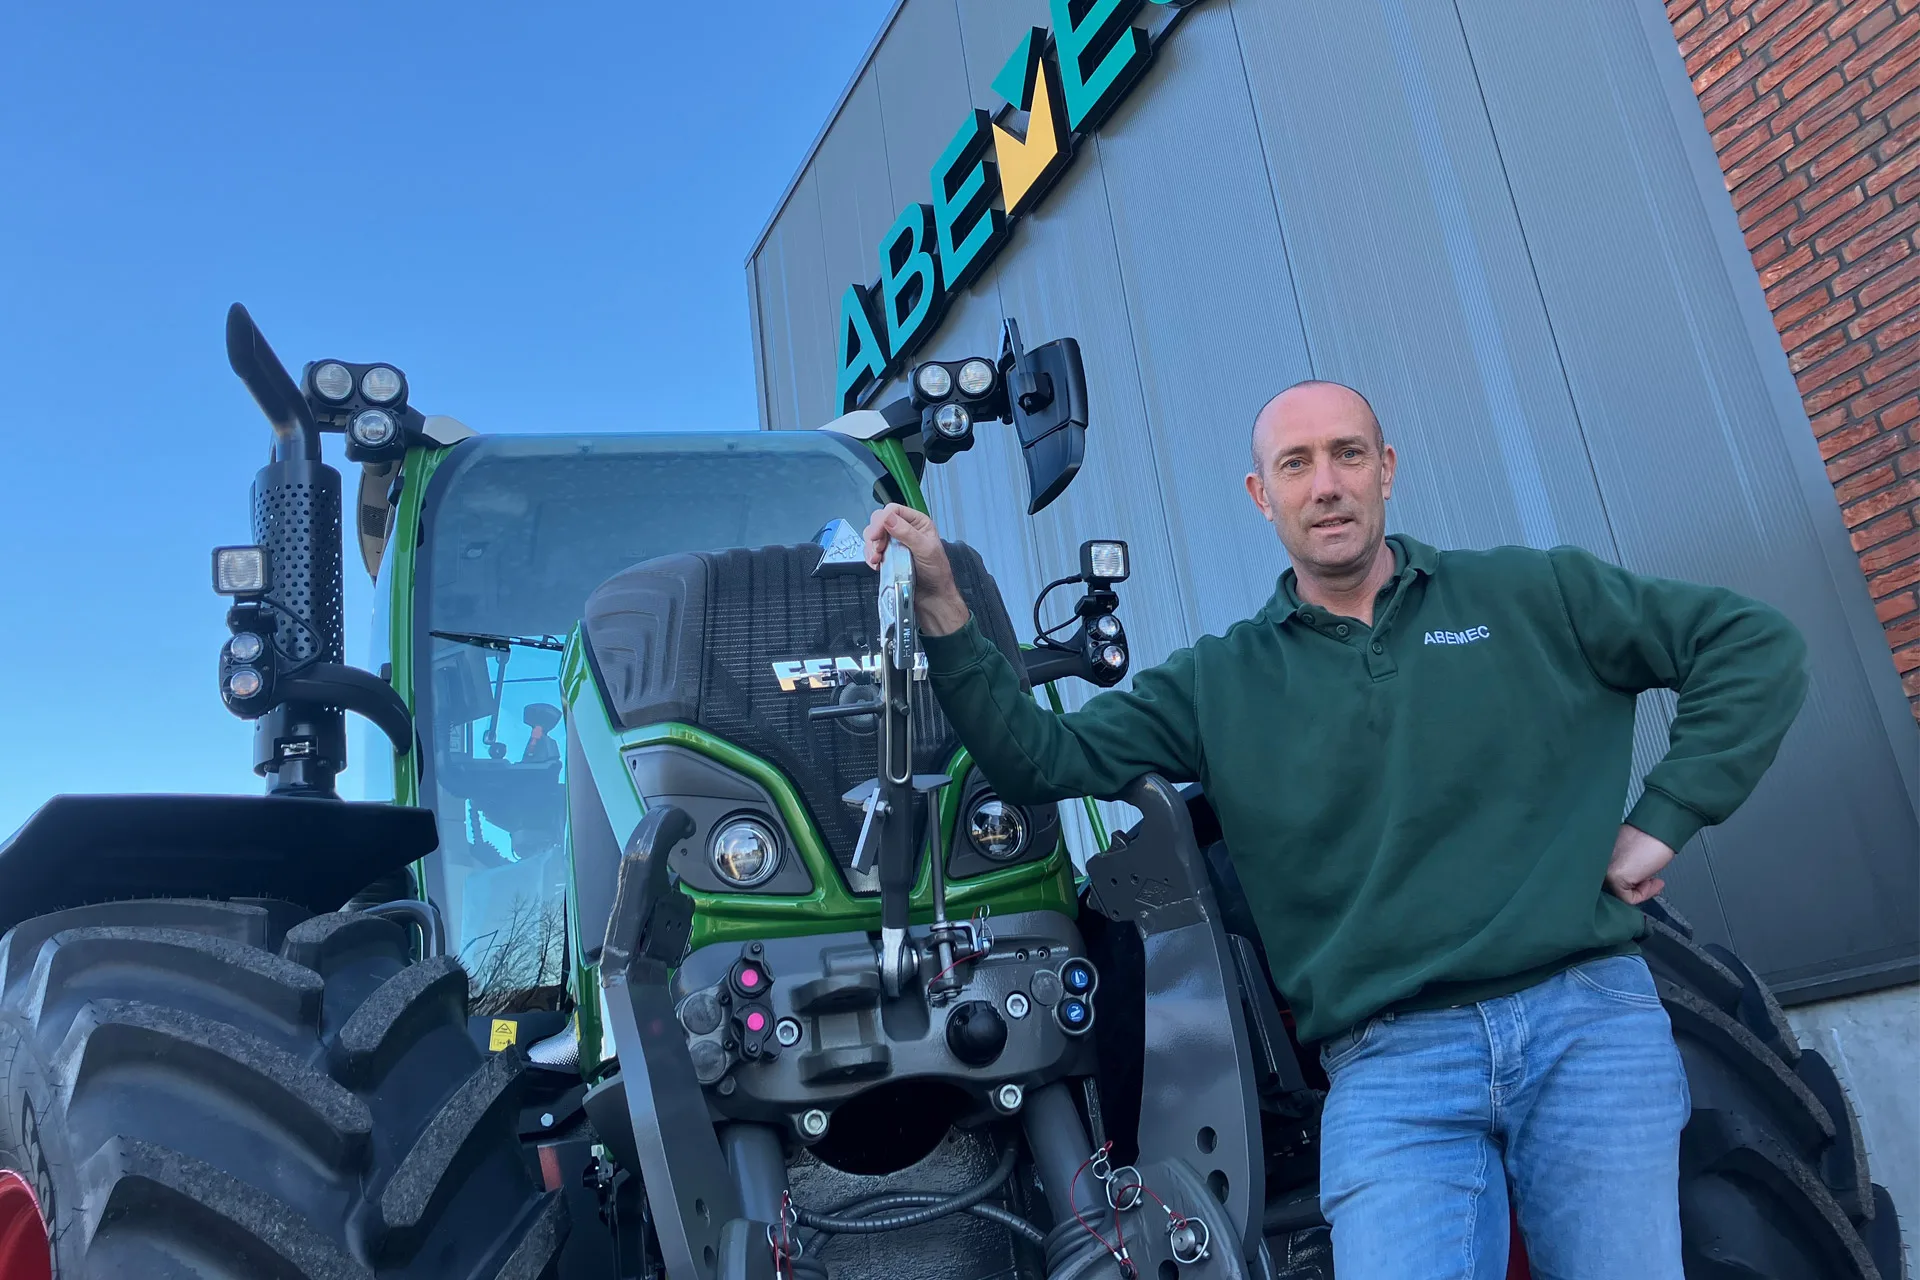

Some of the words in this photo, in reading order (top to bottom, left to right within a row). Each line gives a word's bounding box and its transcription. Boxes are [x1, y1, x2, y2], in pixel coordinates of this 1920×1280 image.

[835, 0, 1178, 416] ABEME
[1424, 625, 1490, 645] ABEMEC
[772, 651, 930, 692] FEN
